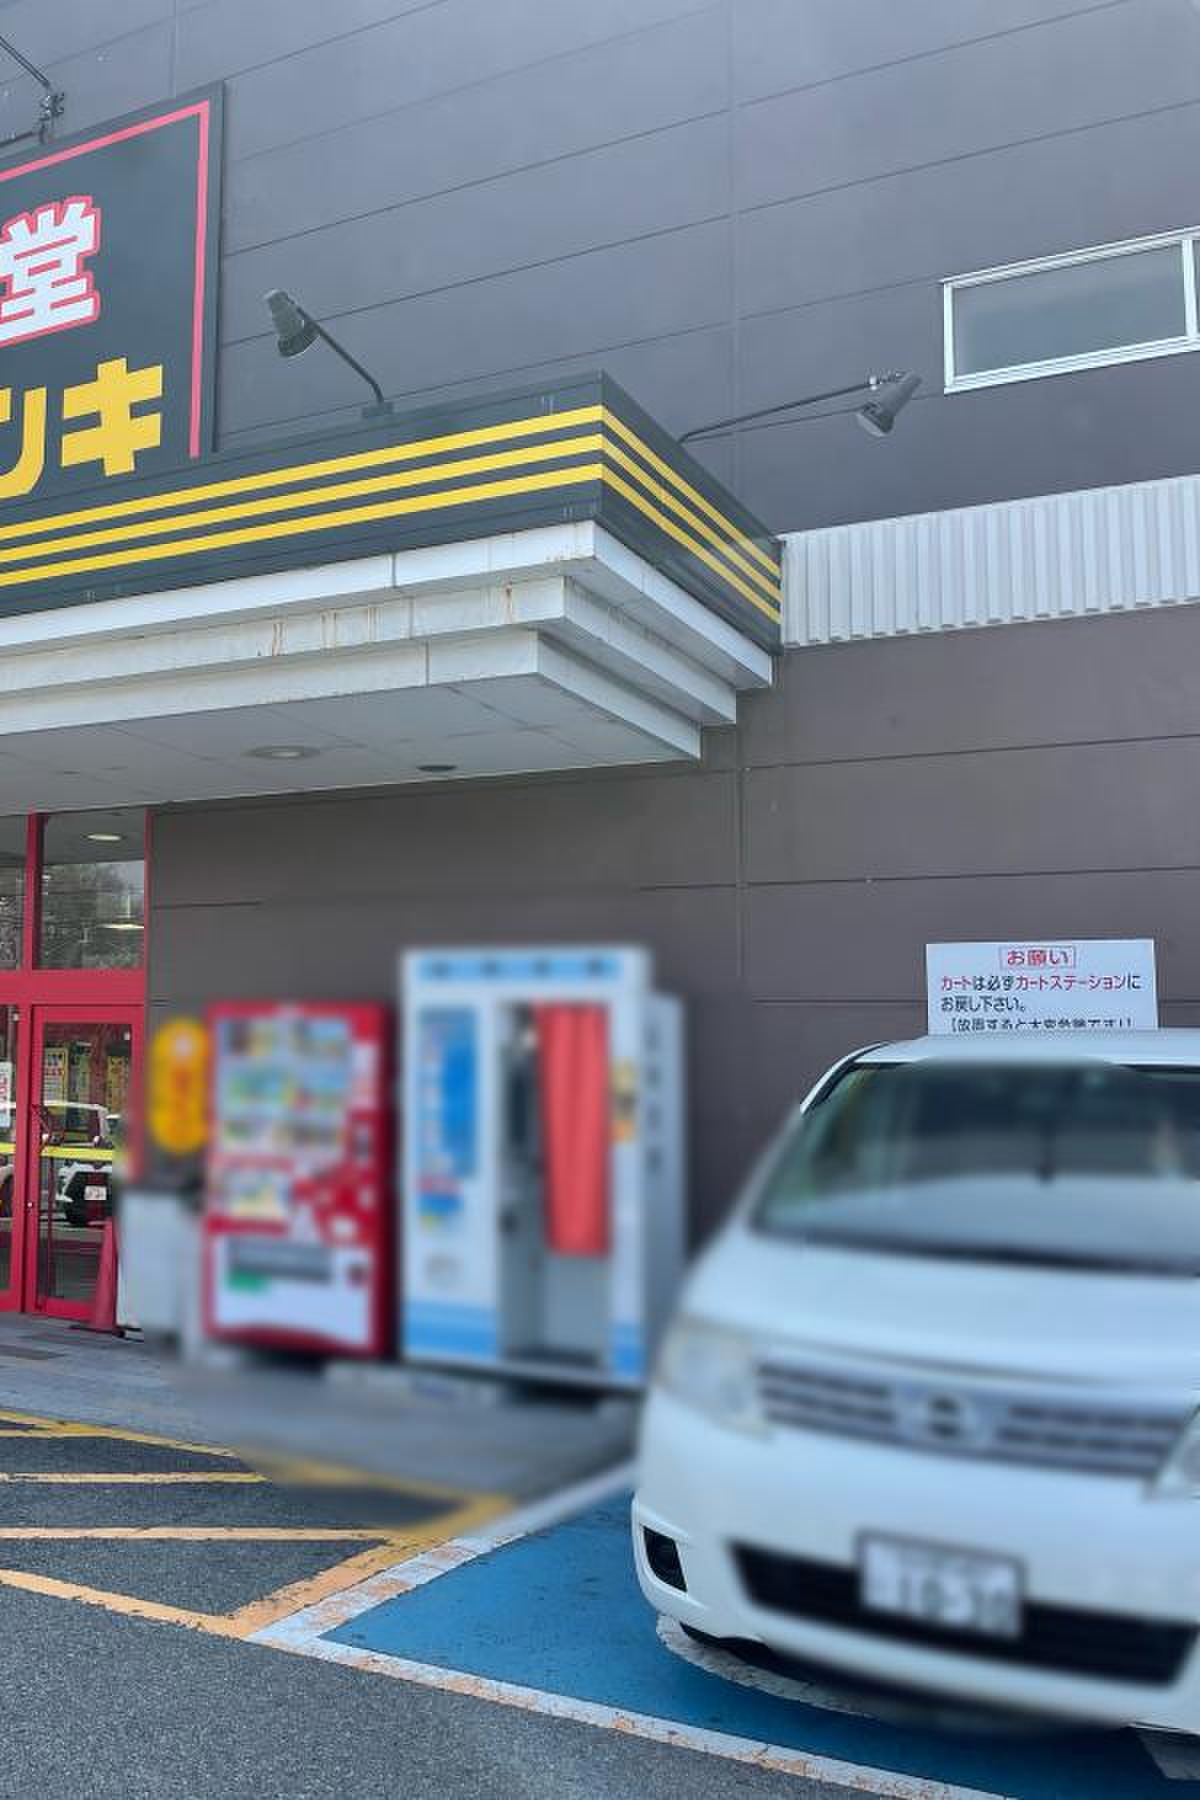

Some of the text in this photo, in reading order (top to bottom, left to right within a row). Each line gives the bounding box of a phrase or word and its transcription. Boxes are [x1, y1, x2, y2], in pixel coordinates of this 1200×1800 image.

[1007, 950, 1069, 966] お願い
[941, 975, 1141, 991] カートは必ずカートステーションに
[941, 996, 1026, 1012] お戻し下さい。
